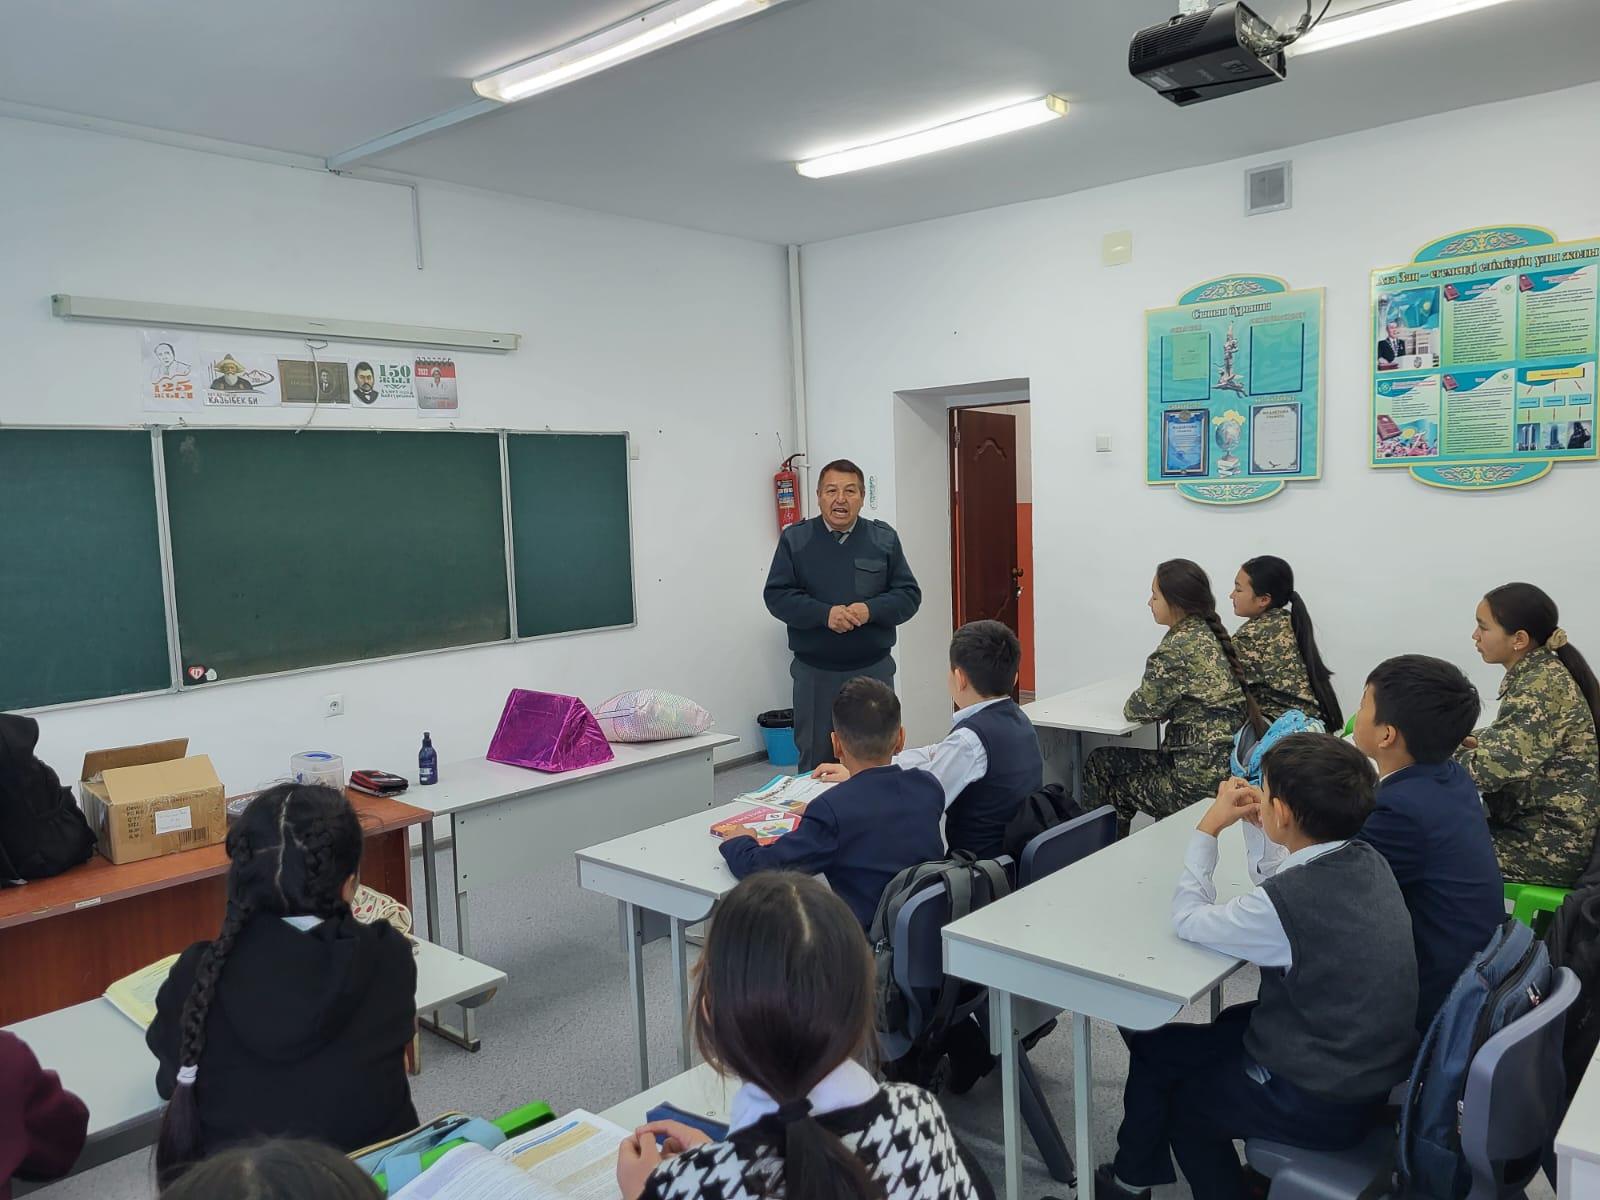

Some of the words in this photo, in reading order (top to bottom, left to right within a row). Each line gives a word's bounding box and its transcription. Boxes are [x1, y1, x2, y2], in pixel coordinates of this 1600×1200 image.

[1563, 247, 1600, 261] жолы
[379, 364, 411, 378] 150
[154, 379, 193, 392] 125
